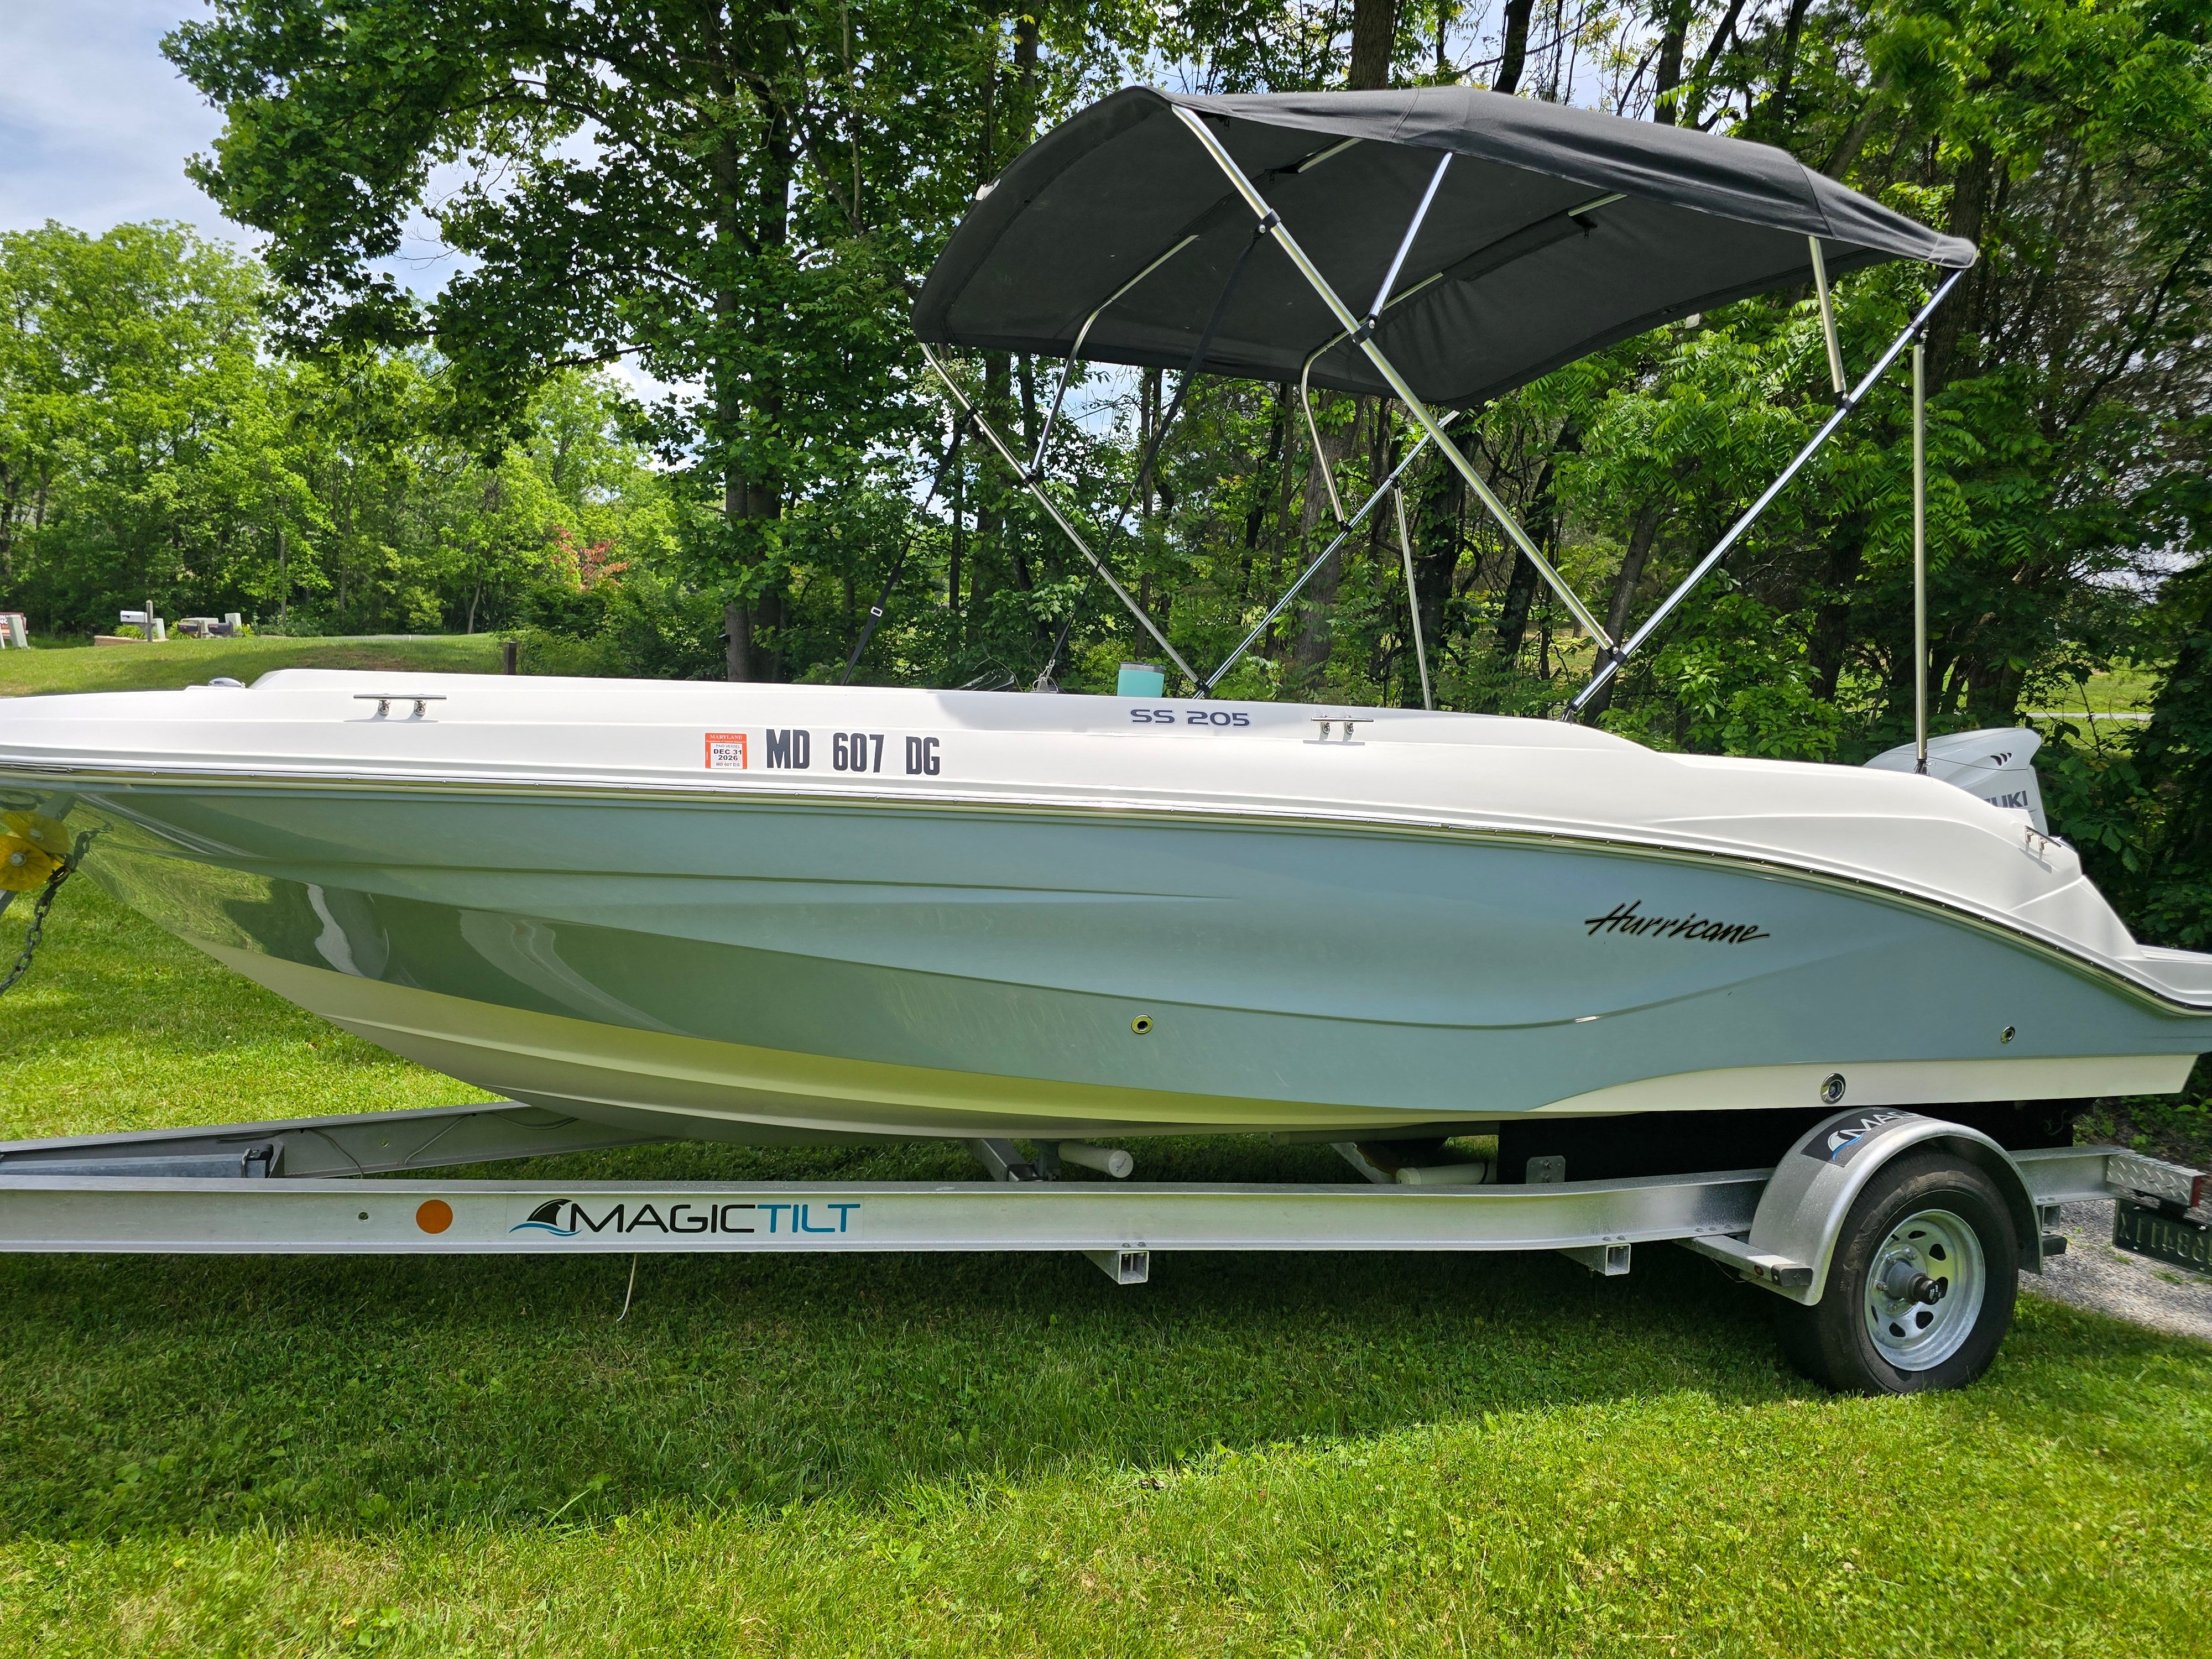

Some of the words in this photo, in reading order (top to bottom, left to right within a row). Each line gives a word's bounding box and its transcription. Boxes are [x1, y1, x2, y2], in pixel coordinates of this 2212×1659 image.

[1130, 709, 1175, 724] SS
[1186, 711, 1250, 727] 205
[766, 729, 810, 769] MD
[833, 732, 884, 773] 607
[906, 736, 940, 776] DG
[1584, 900, 1770, 944] Hurricane
[570, 1203, 860, 1234] MAGICTILT
